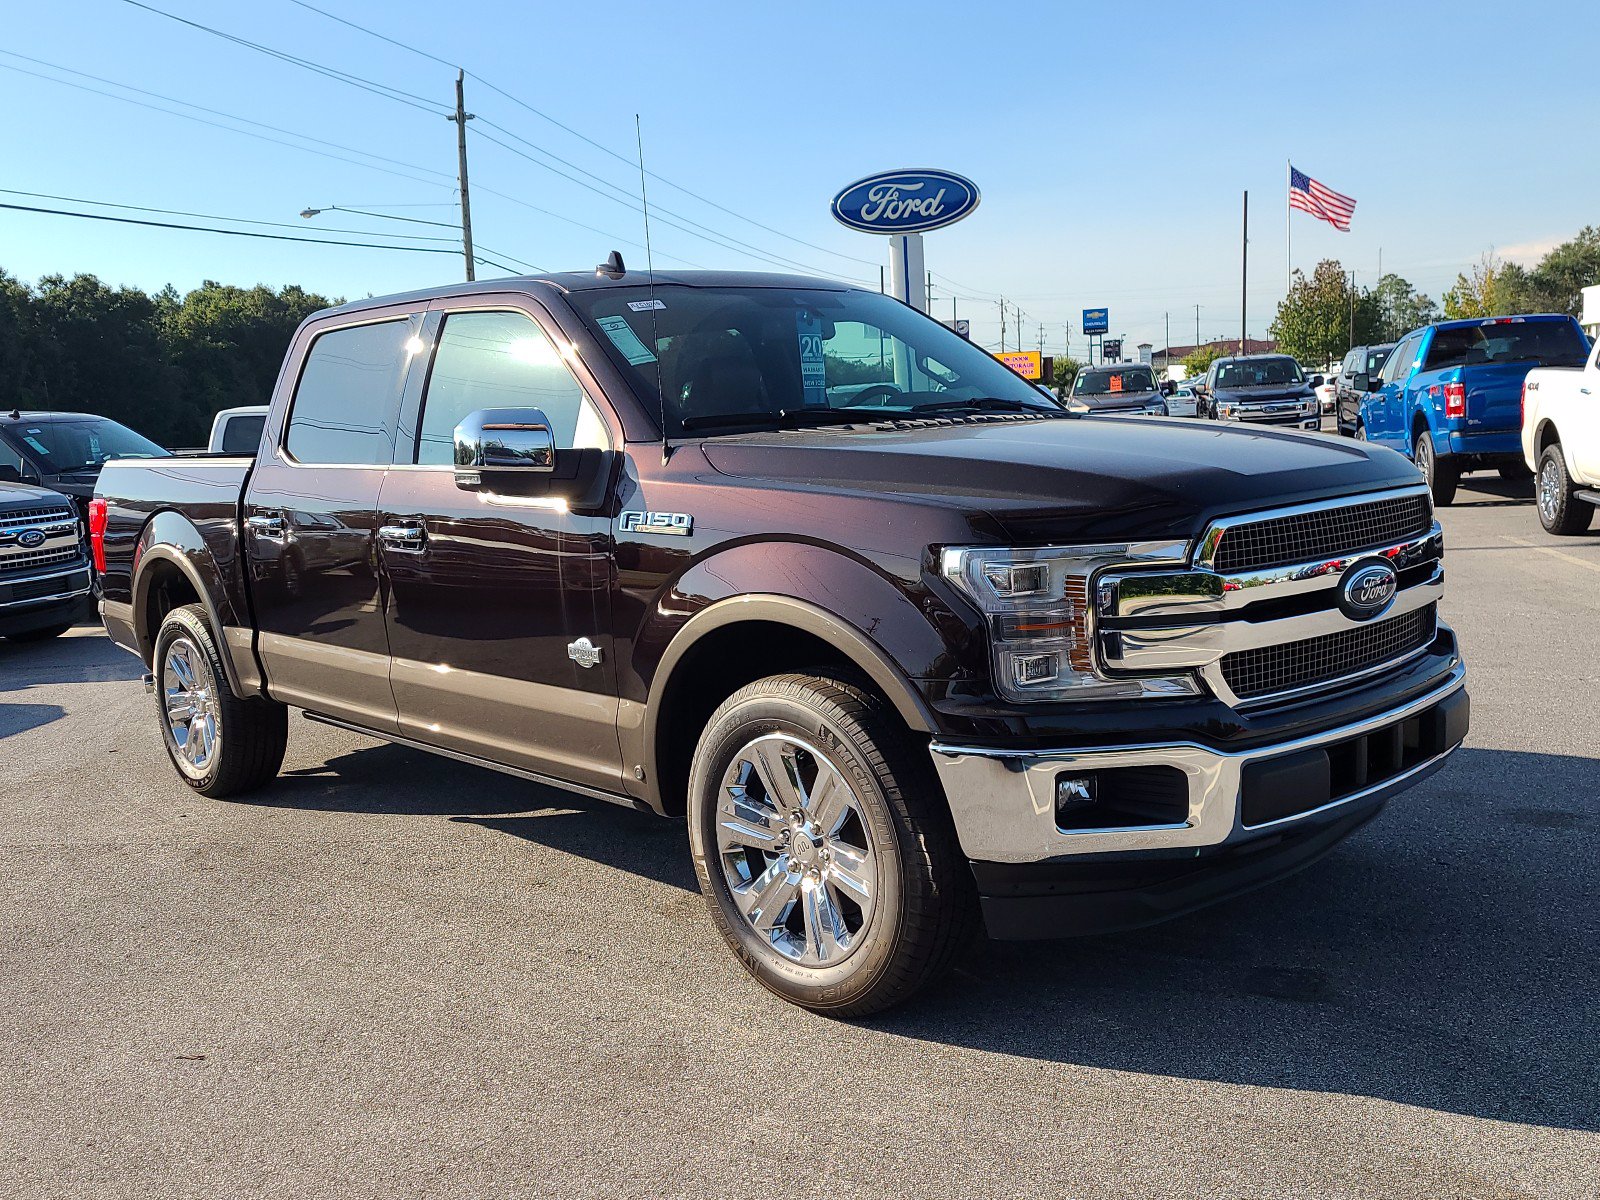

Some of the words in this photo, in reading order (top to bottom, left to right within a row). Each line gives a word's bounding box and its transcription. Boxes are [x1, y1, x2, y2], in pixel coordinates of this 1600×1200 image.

[861, 182, 946, 221] Ford
[1360, 575, 1388, 601] Ford
[834, 743, 893, 845] MICHELIN
